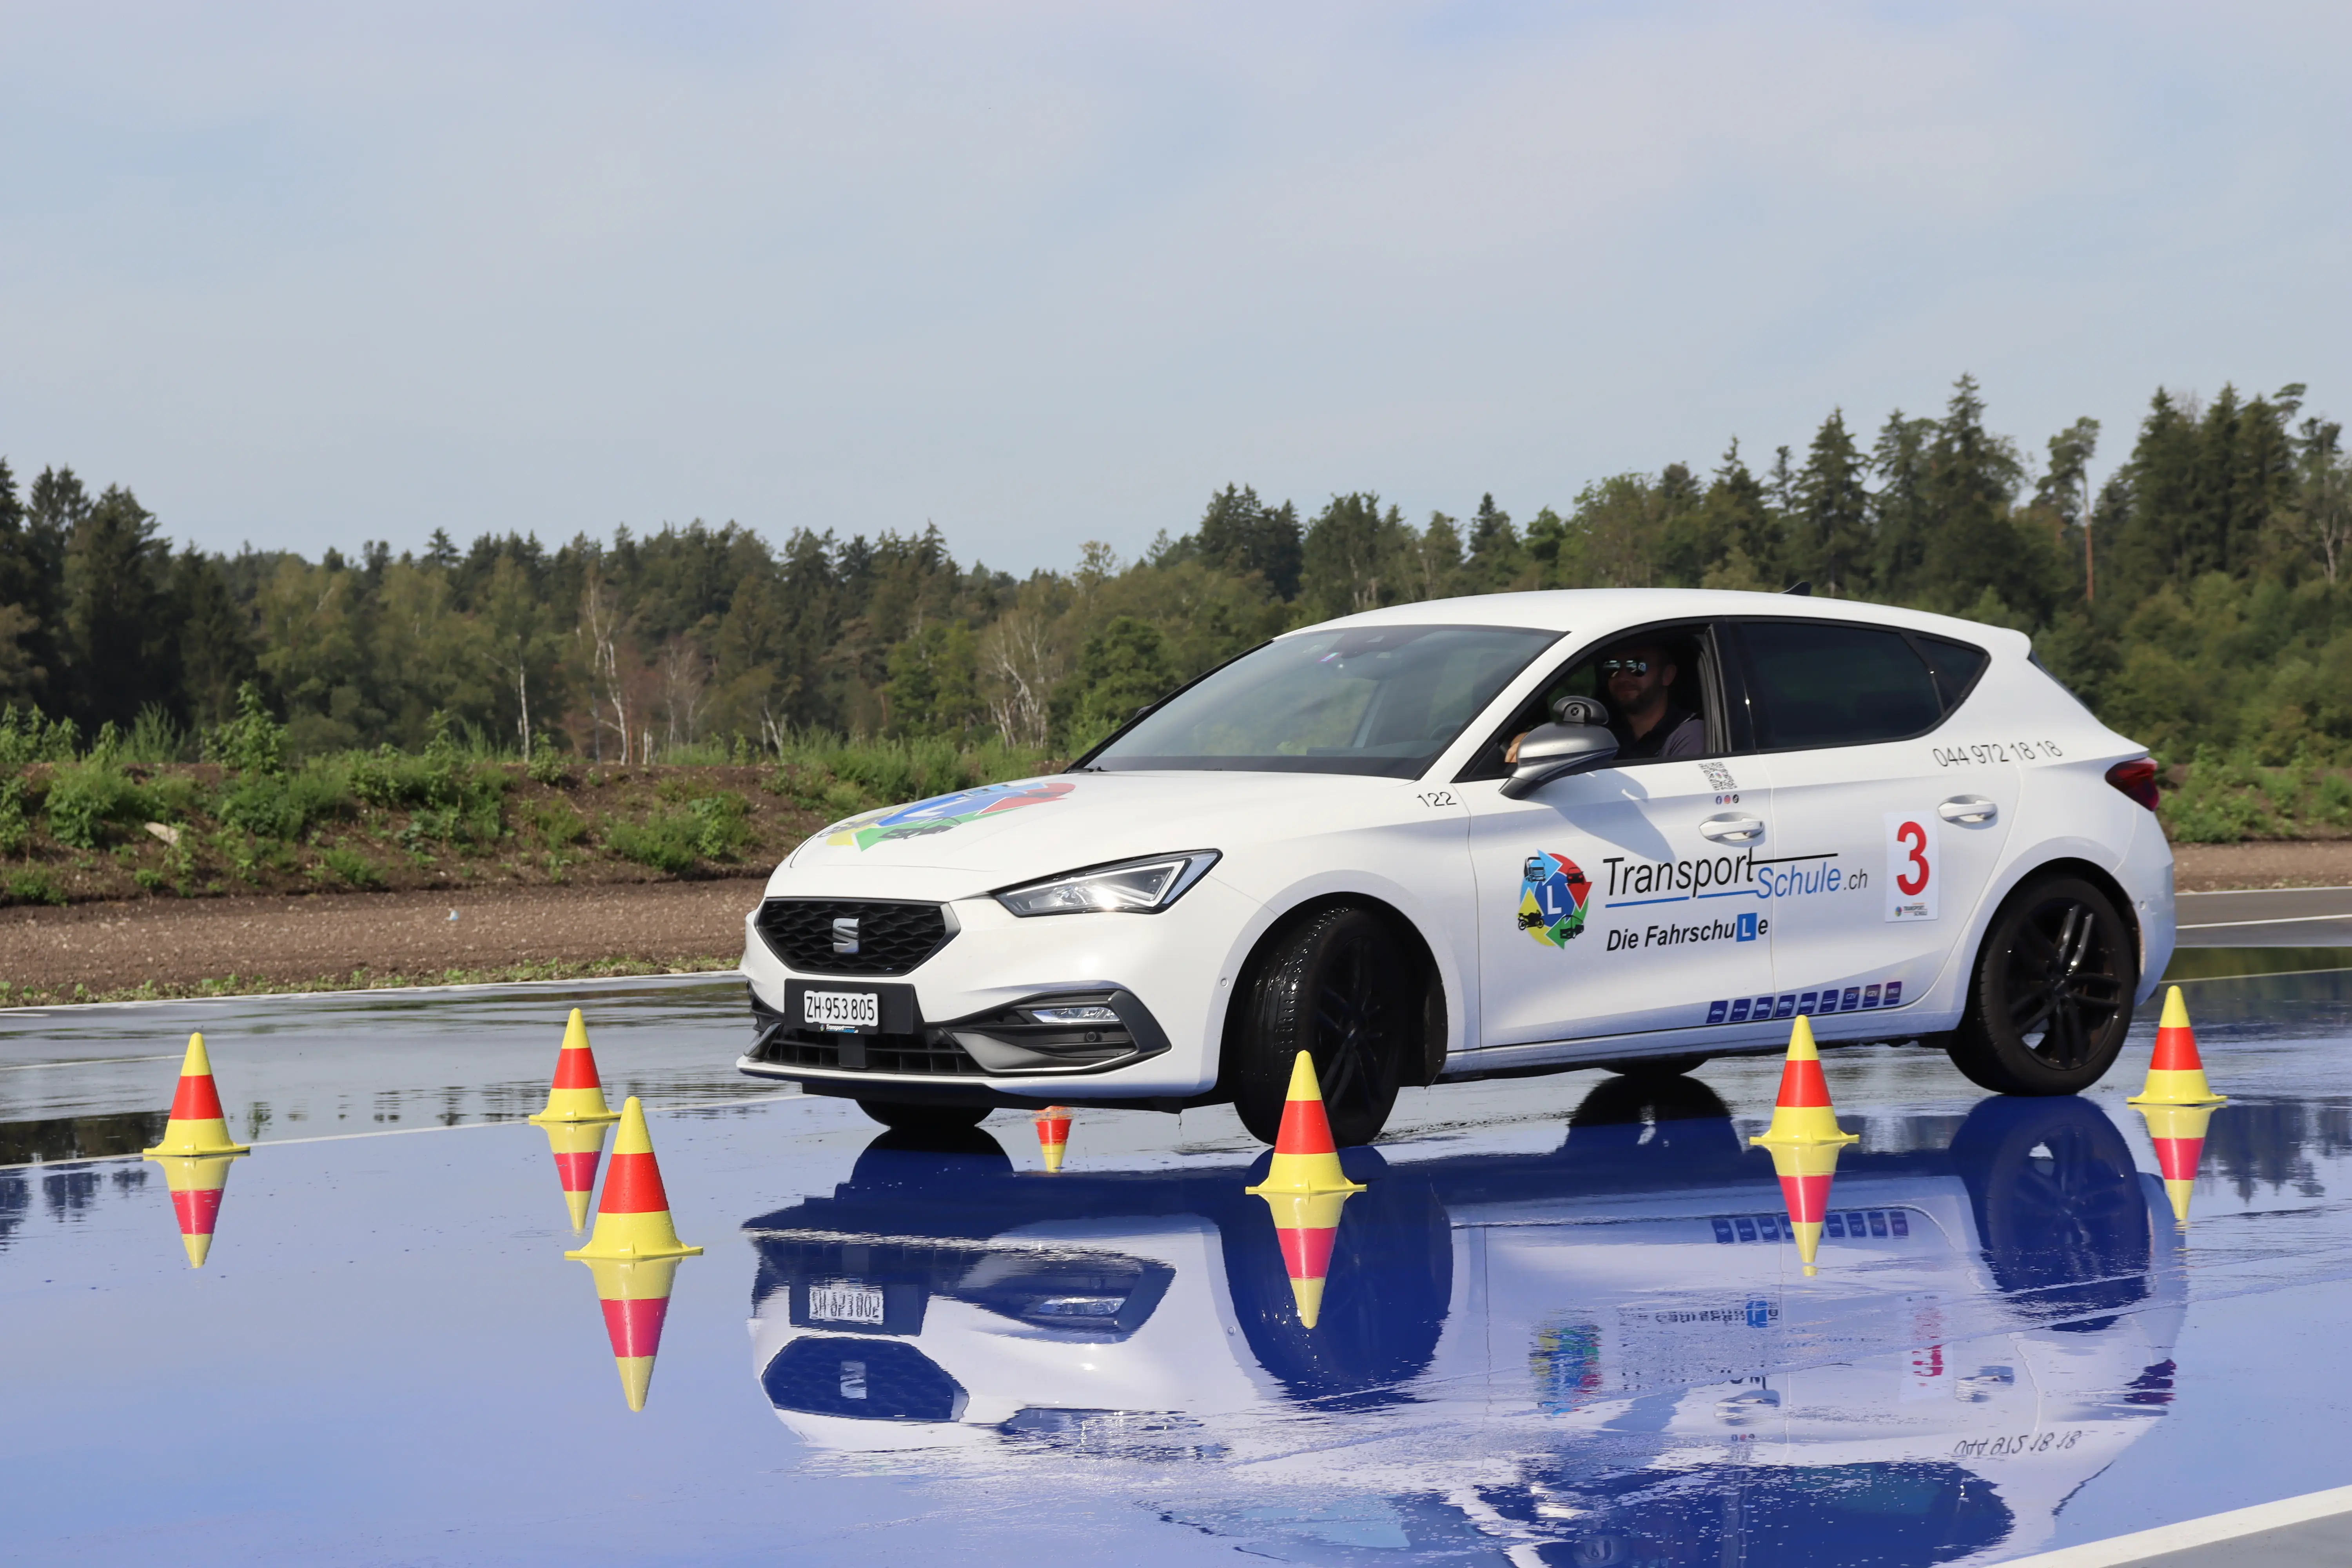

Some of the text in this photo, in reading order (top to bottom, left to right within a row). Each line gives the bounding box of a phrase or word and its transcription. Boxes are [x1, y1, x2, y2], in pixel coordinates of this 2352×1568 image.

[1933, 740, 2063, 766] 044 972 18 18
[1416, 791, 1457, 807] 122
[1602, 846, 1754, 897] Transport
[1896, 821, 1929, 896] 3
[1546, 885, 1562, 915] L
[1606, 929, 1639, 951] Die
